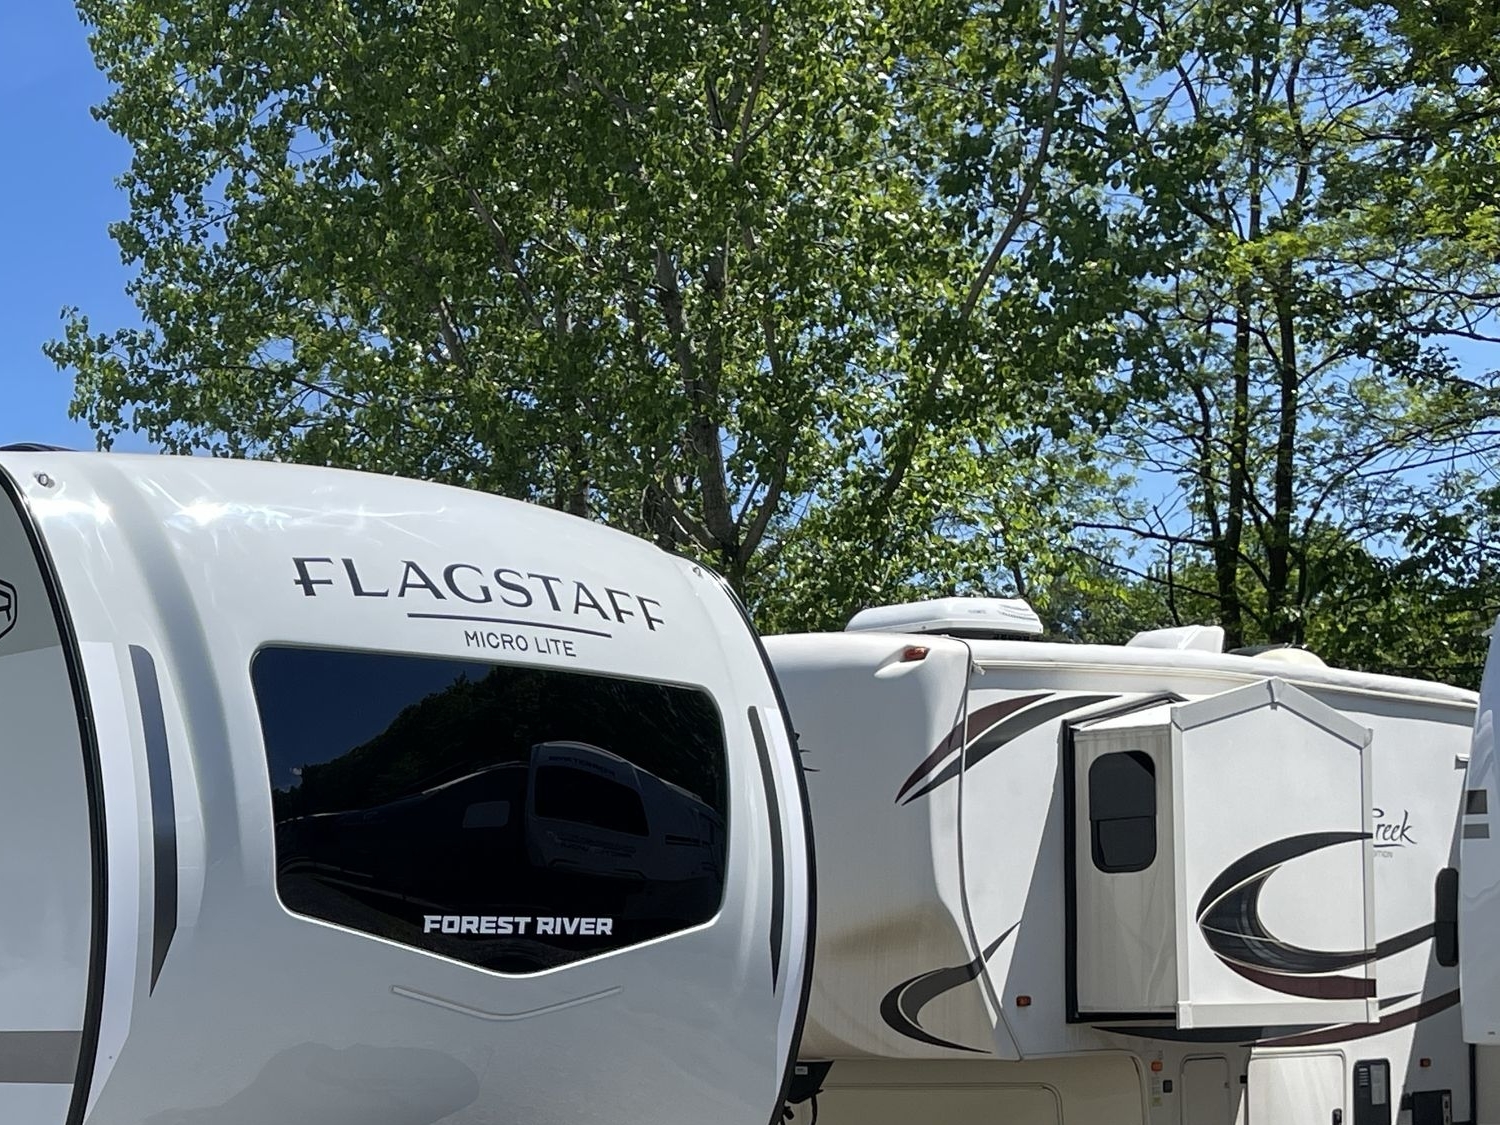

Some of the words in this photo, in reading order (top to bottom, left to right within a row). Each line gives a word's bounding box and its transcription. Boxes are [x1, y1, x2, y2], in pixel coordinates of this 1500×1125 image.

[292, 556, 665, 632] FLAGSTAFF
[463, 630, 529, 652] MICRO
[534, 636, 577, 657] LITE
[423, 915, 531, 934] FOREST
[536, 917, 613, 935] RIVER
